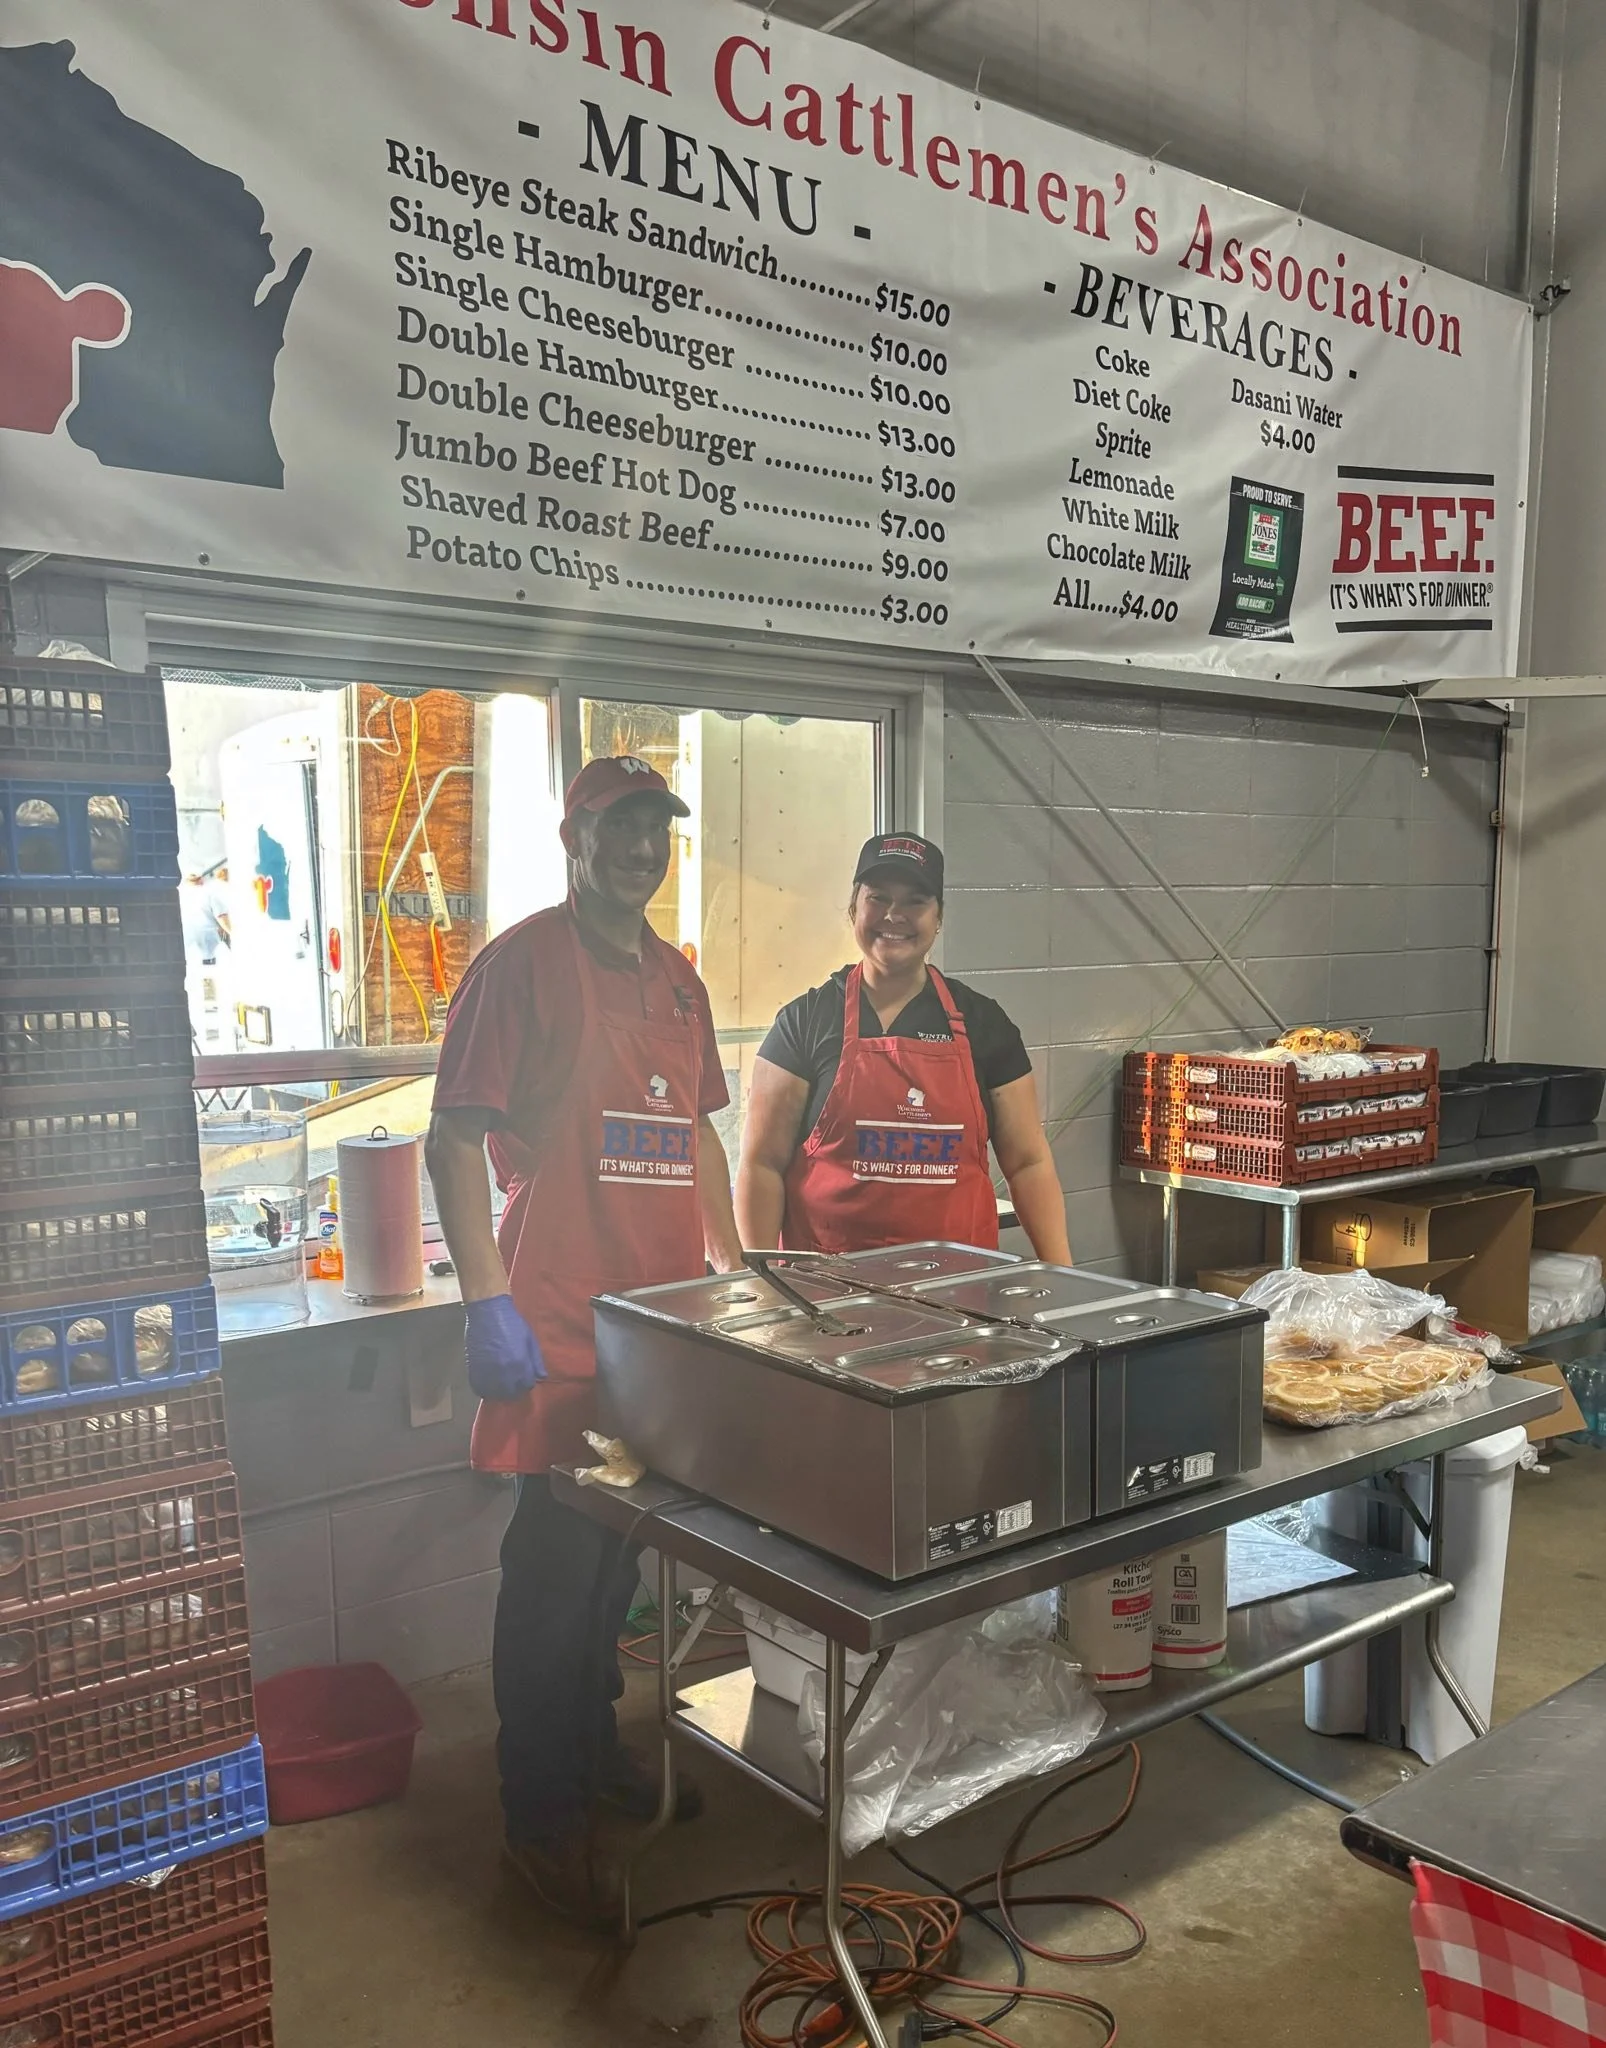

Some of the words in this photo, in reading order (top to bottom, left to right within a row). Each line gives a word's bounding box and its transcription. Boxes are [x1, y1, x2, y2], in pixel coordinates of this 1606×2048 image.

[400, 0, 673, 97] nsin
[714, 35, 1160, 257] Cattlemen's
[1178, 204, 1463, 358] Association
[579, 100, 822, 236] MENU
[386, 139, 509, 209] Ribeye
[521, 179, 619, 236] Steak
[628, 208, 777, 280] Sandwich
[875, 283, 950, 327] $15.00
[389, 197, 504, 260] Single
[514, 232, 703, 312] Hamburger
[870, 333, 947, 375] $10.00
[395, 254, 510, 317] Single
[517, 286, 735, 370] Cheeseburger
[871, 375, 950, 414] $10.00
[1070, 262, 1334, 384] BEVERAGES
[398, 306, 528, 366] Double
[537, 339, 720, 411] Hamburger
[878, 420, 955, 457] $13.00
[1096, 345, 1150, 377] Coke
[1073, 379, 1120, 410] Diet
[1126, 389, 1171, 423] Coke
[1231, 378, 1292, 415] Dasani
[1296, 395, 1343, 428] Water
[397, 363, 528, 420] Double
[538, 392, 758, 468] Cheeseburger
[881, 465, 955, 503] $13.00
[1096, 422, 1151, 459] Sprite
[1260, 420, 1315, 453] $4.00
[395, 420, 517, 471] Jumbo
[527, 442, 607, 485] Beef
[612, 457, 670, 495] Hot
[678, 469, 736, 515] Dog
[881, 509, 945, 543] $7.00
[1069, 458, 1174, 500] Lemonade
[1242, 484, 1264, 501] PROUD
[1265, 490, 1273, 504] TO
[1273, 492, 1293, 508] SERVE
[401, 475, 527, 525] Shaved
[537, 496, 631, 539] Roast
[639, 511, 714, 549] Beef
[882, 549, 948, 582] $9.00
[1062, 497, 1129, 530] White
[1134, 509, 1179, 540] Milk
[1252, 524, 1278, 540] JONES
[407, 526, 521, 571] Potato
[530, 545, 619, 591] Chips
[879, 598, 949, 627] $3.00
[1047, 533, 1145, 572] Chocolate
[1149, 551, 1191, 580] Milk
[1232, 573, 1256, 589] Locally
[1257, 578, 1275, 590] Made
[1330, 584, 1358, 609] IT'S
[1359, 583, 1417, 608] WHAT'S
[1419, 582, 1444, 607] FOR
[1225, 620, 1253, 632] MEALTIME
[1248, 599, 1266, 610] BACON
[600, 1158, 617, 1171] IT'S
[619, 1160, 654, 1173] WHAT'S
[655, 1162, 670, 1175] FOR
[853, 1160, 868, 1172] IT'S
[870, 1161, 903, 1175] WHAT'S
[905, 1164, 921, 1175] FOR
[1113, 1577, 1134, 1588] Roll
[1157, 1625, 1182, 1637] Sysco
